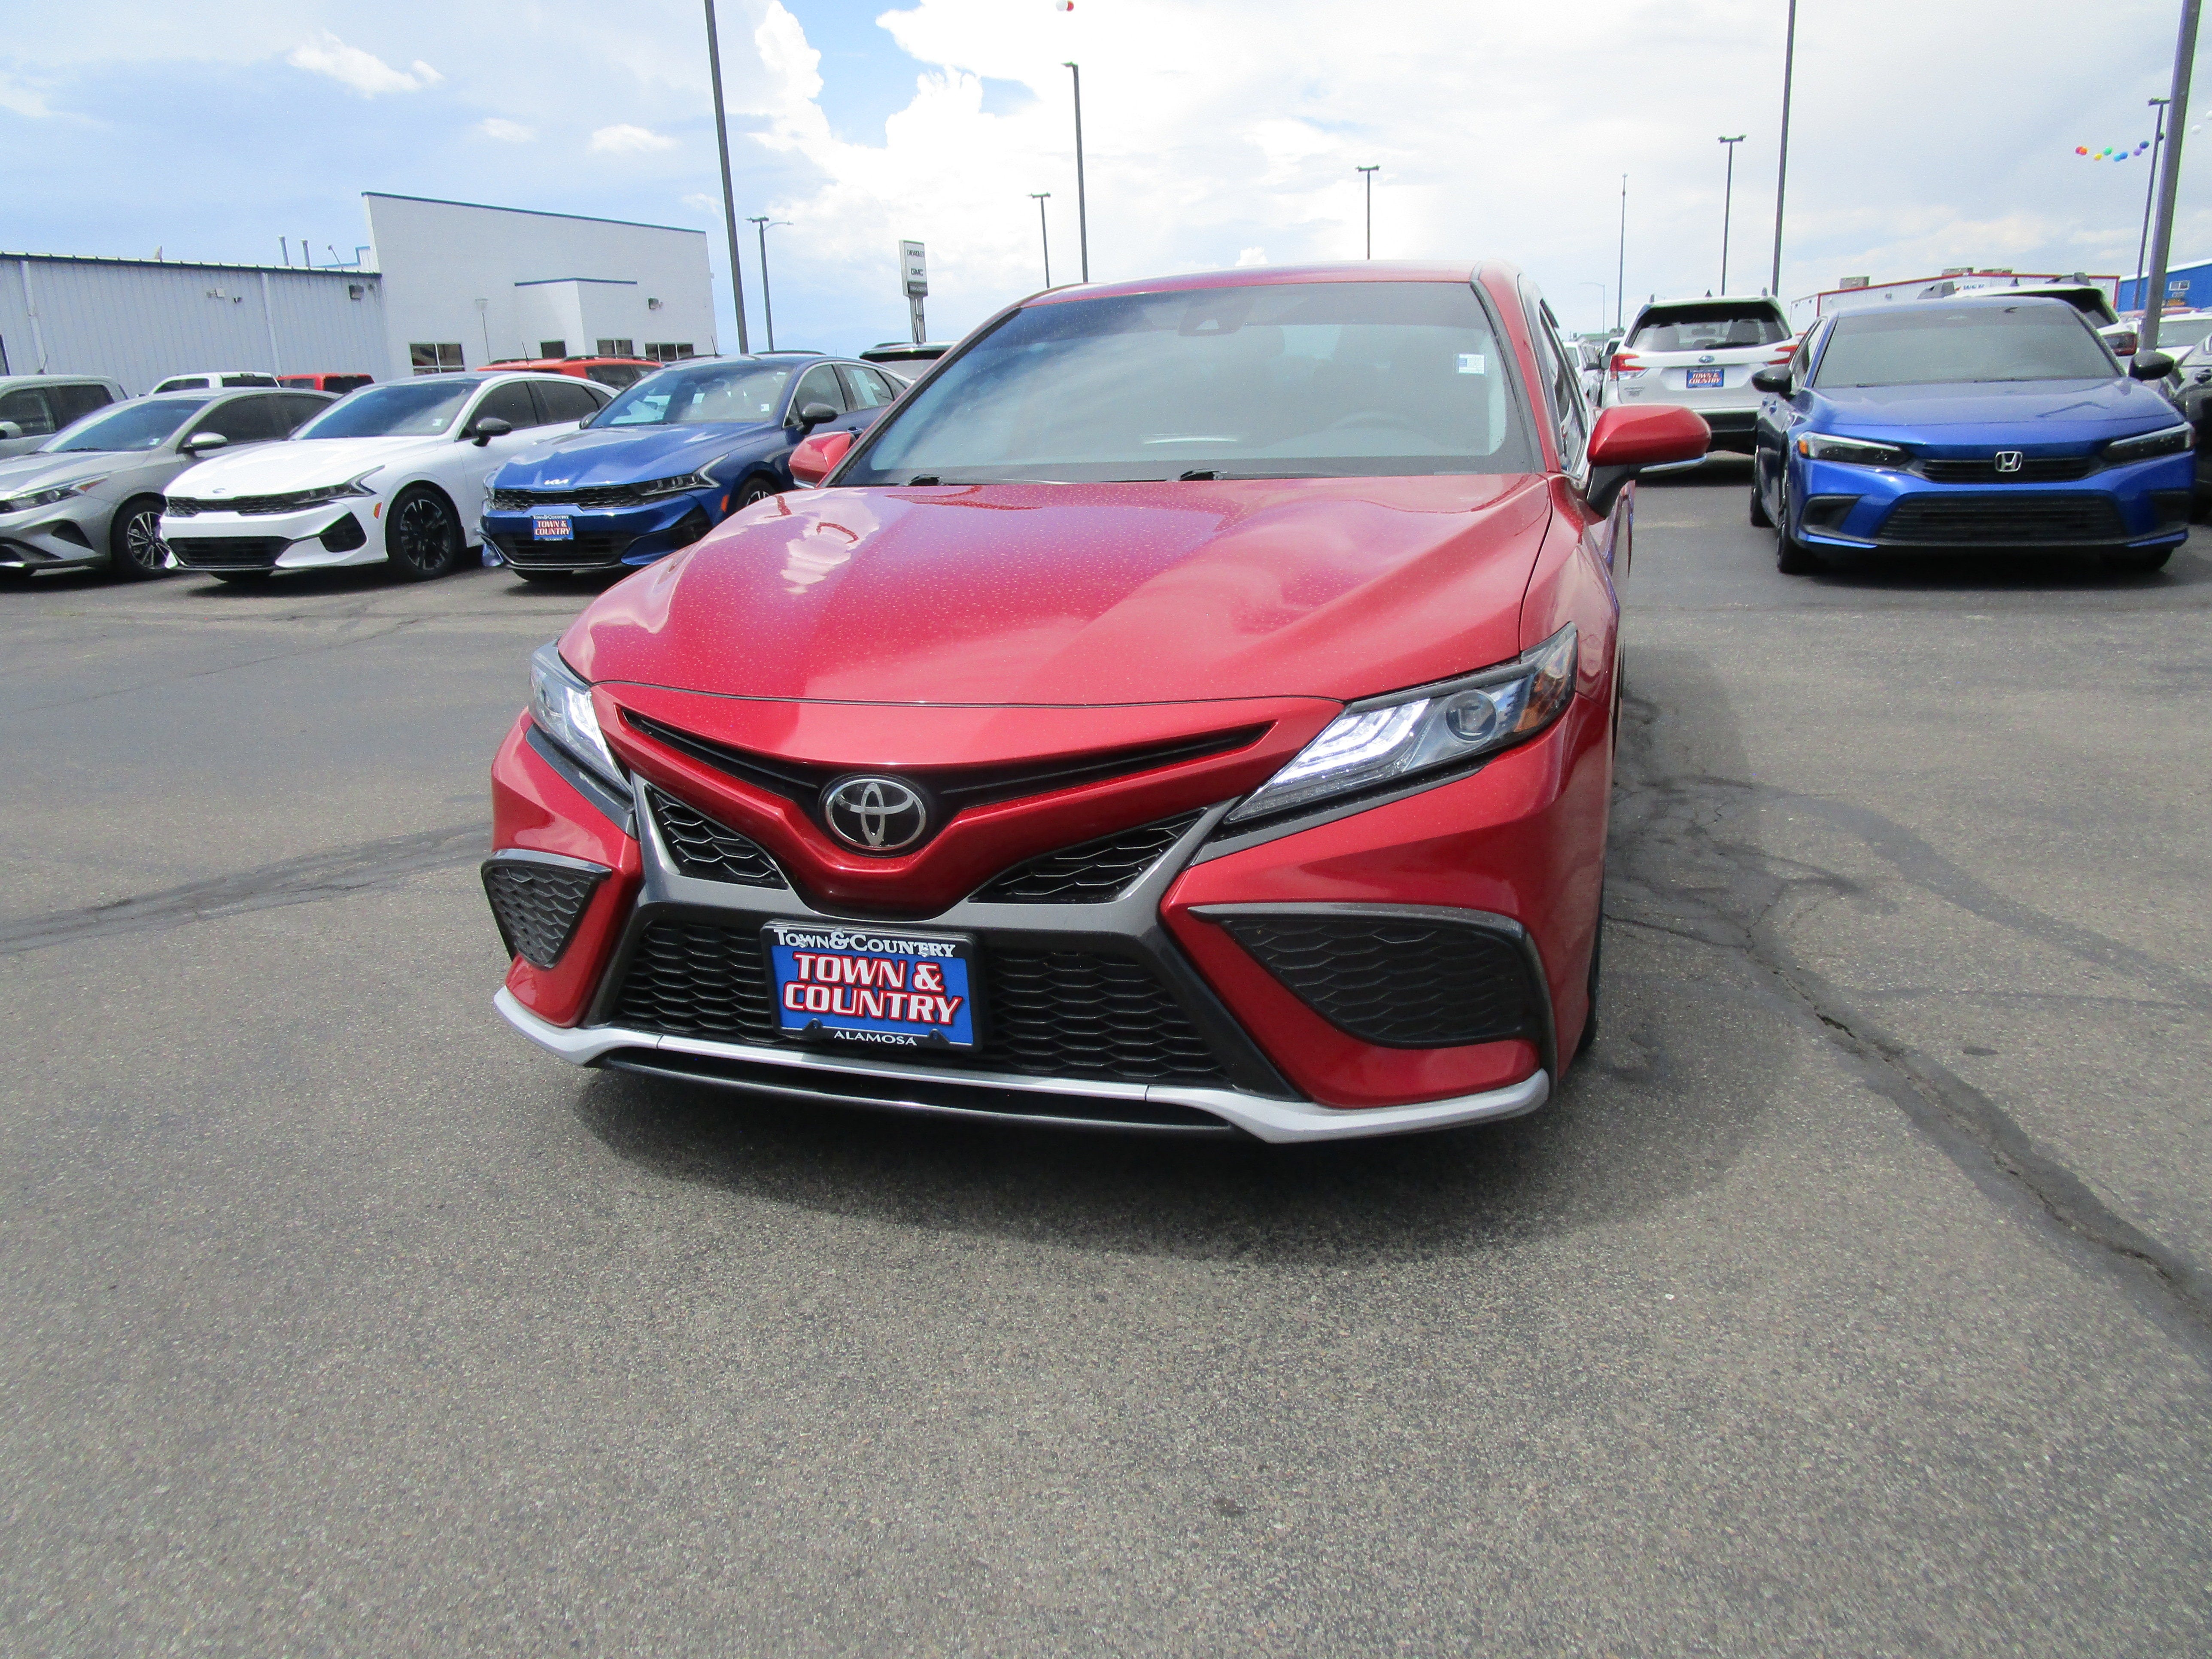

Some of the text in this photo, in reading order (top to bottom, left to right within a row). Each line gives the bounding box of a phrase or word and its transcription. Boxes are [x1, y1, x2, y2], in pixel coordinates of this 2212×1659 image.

[793, 951, 945, 992] TOWN &
[784, 981, 962, 1025] COUNTRY
[834, 1030, 917, 1045] ALAMOSA
